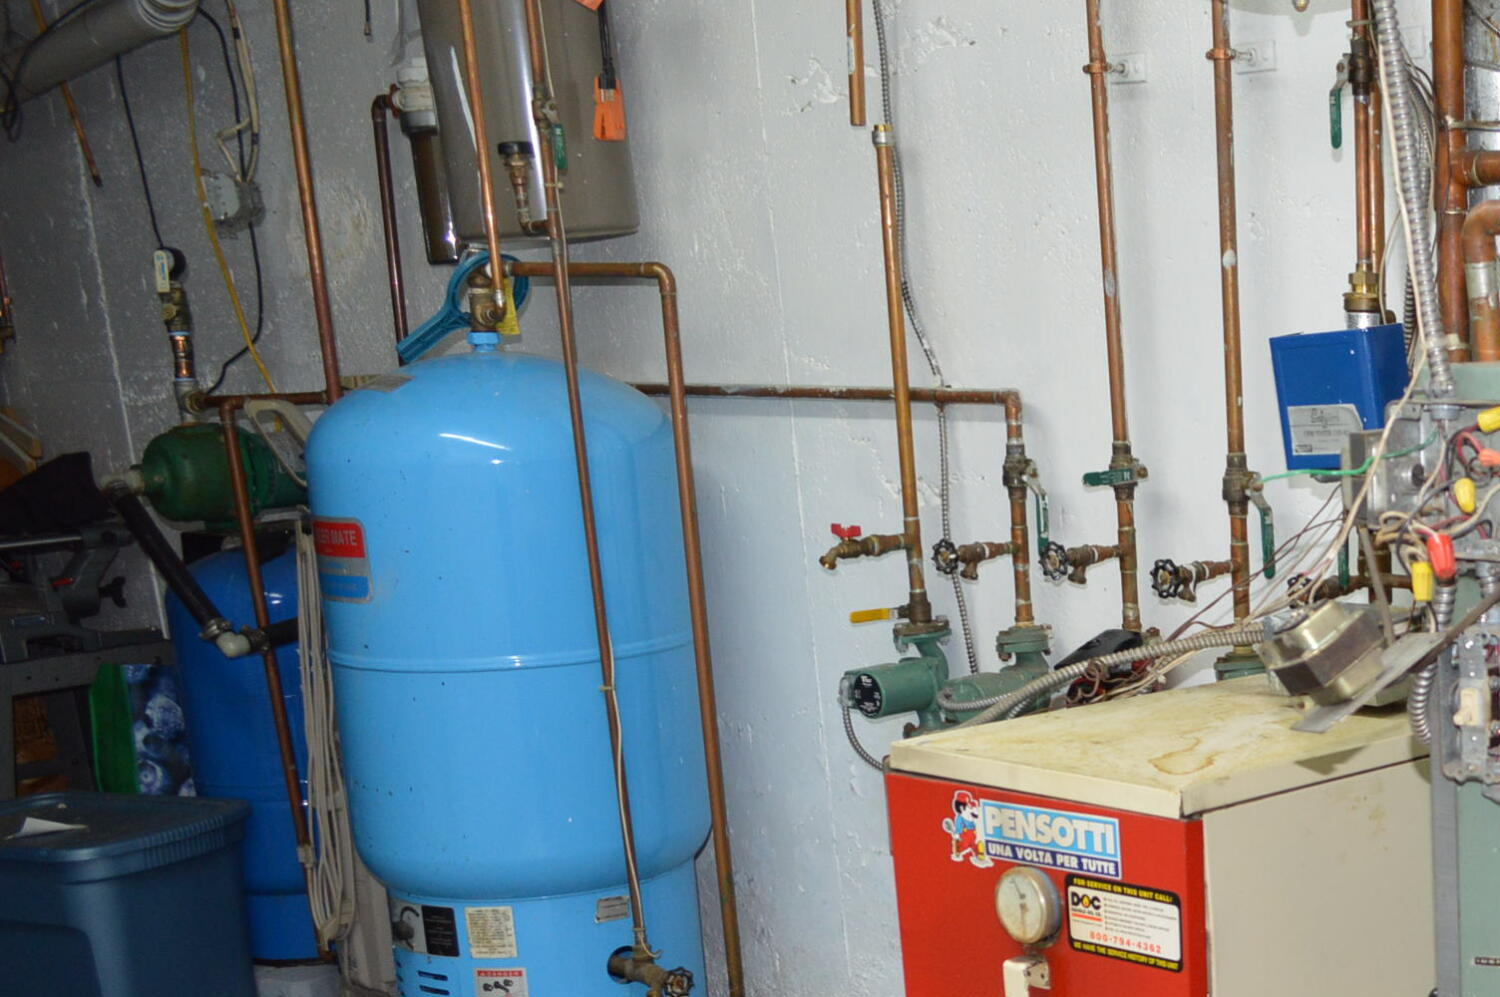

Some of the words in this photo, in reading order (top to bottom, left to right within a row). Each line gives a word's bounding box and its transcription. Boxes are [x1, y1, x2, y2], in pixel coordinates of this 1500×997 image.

[984, 805, 1115, 855] PENSOTTI
[988, 842, 1013, 859] UNA
[1015, 846, 1053, 865] VOLTA
[1056, 853, 1079, 870] PER
[1081, 858, 1117, 876] TUTTE
[1073, 877, 1086, 887] FOR
[1087, 880, 1112, 891] SERVICE
[1113, 884, 1122, 893] ON
[1123, 886, 1138, 897] THIS
[1138, 889, 1153, 899] UNIT
